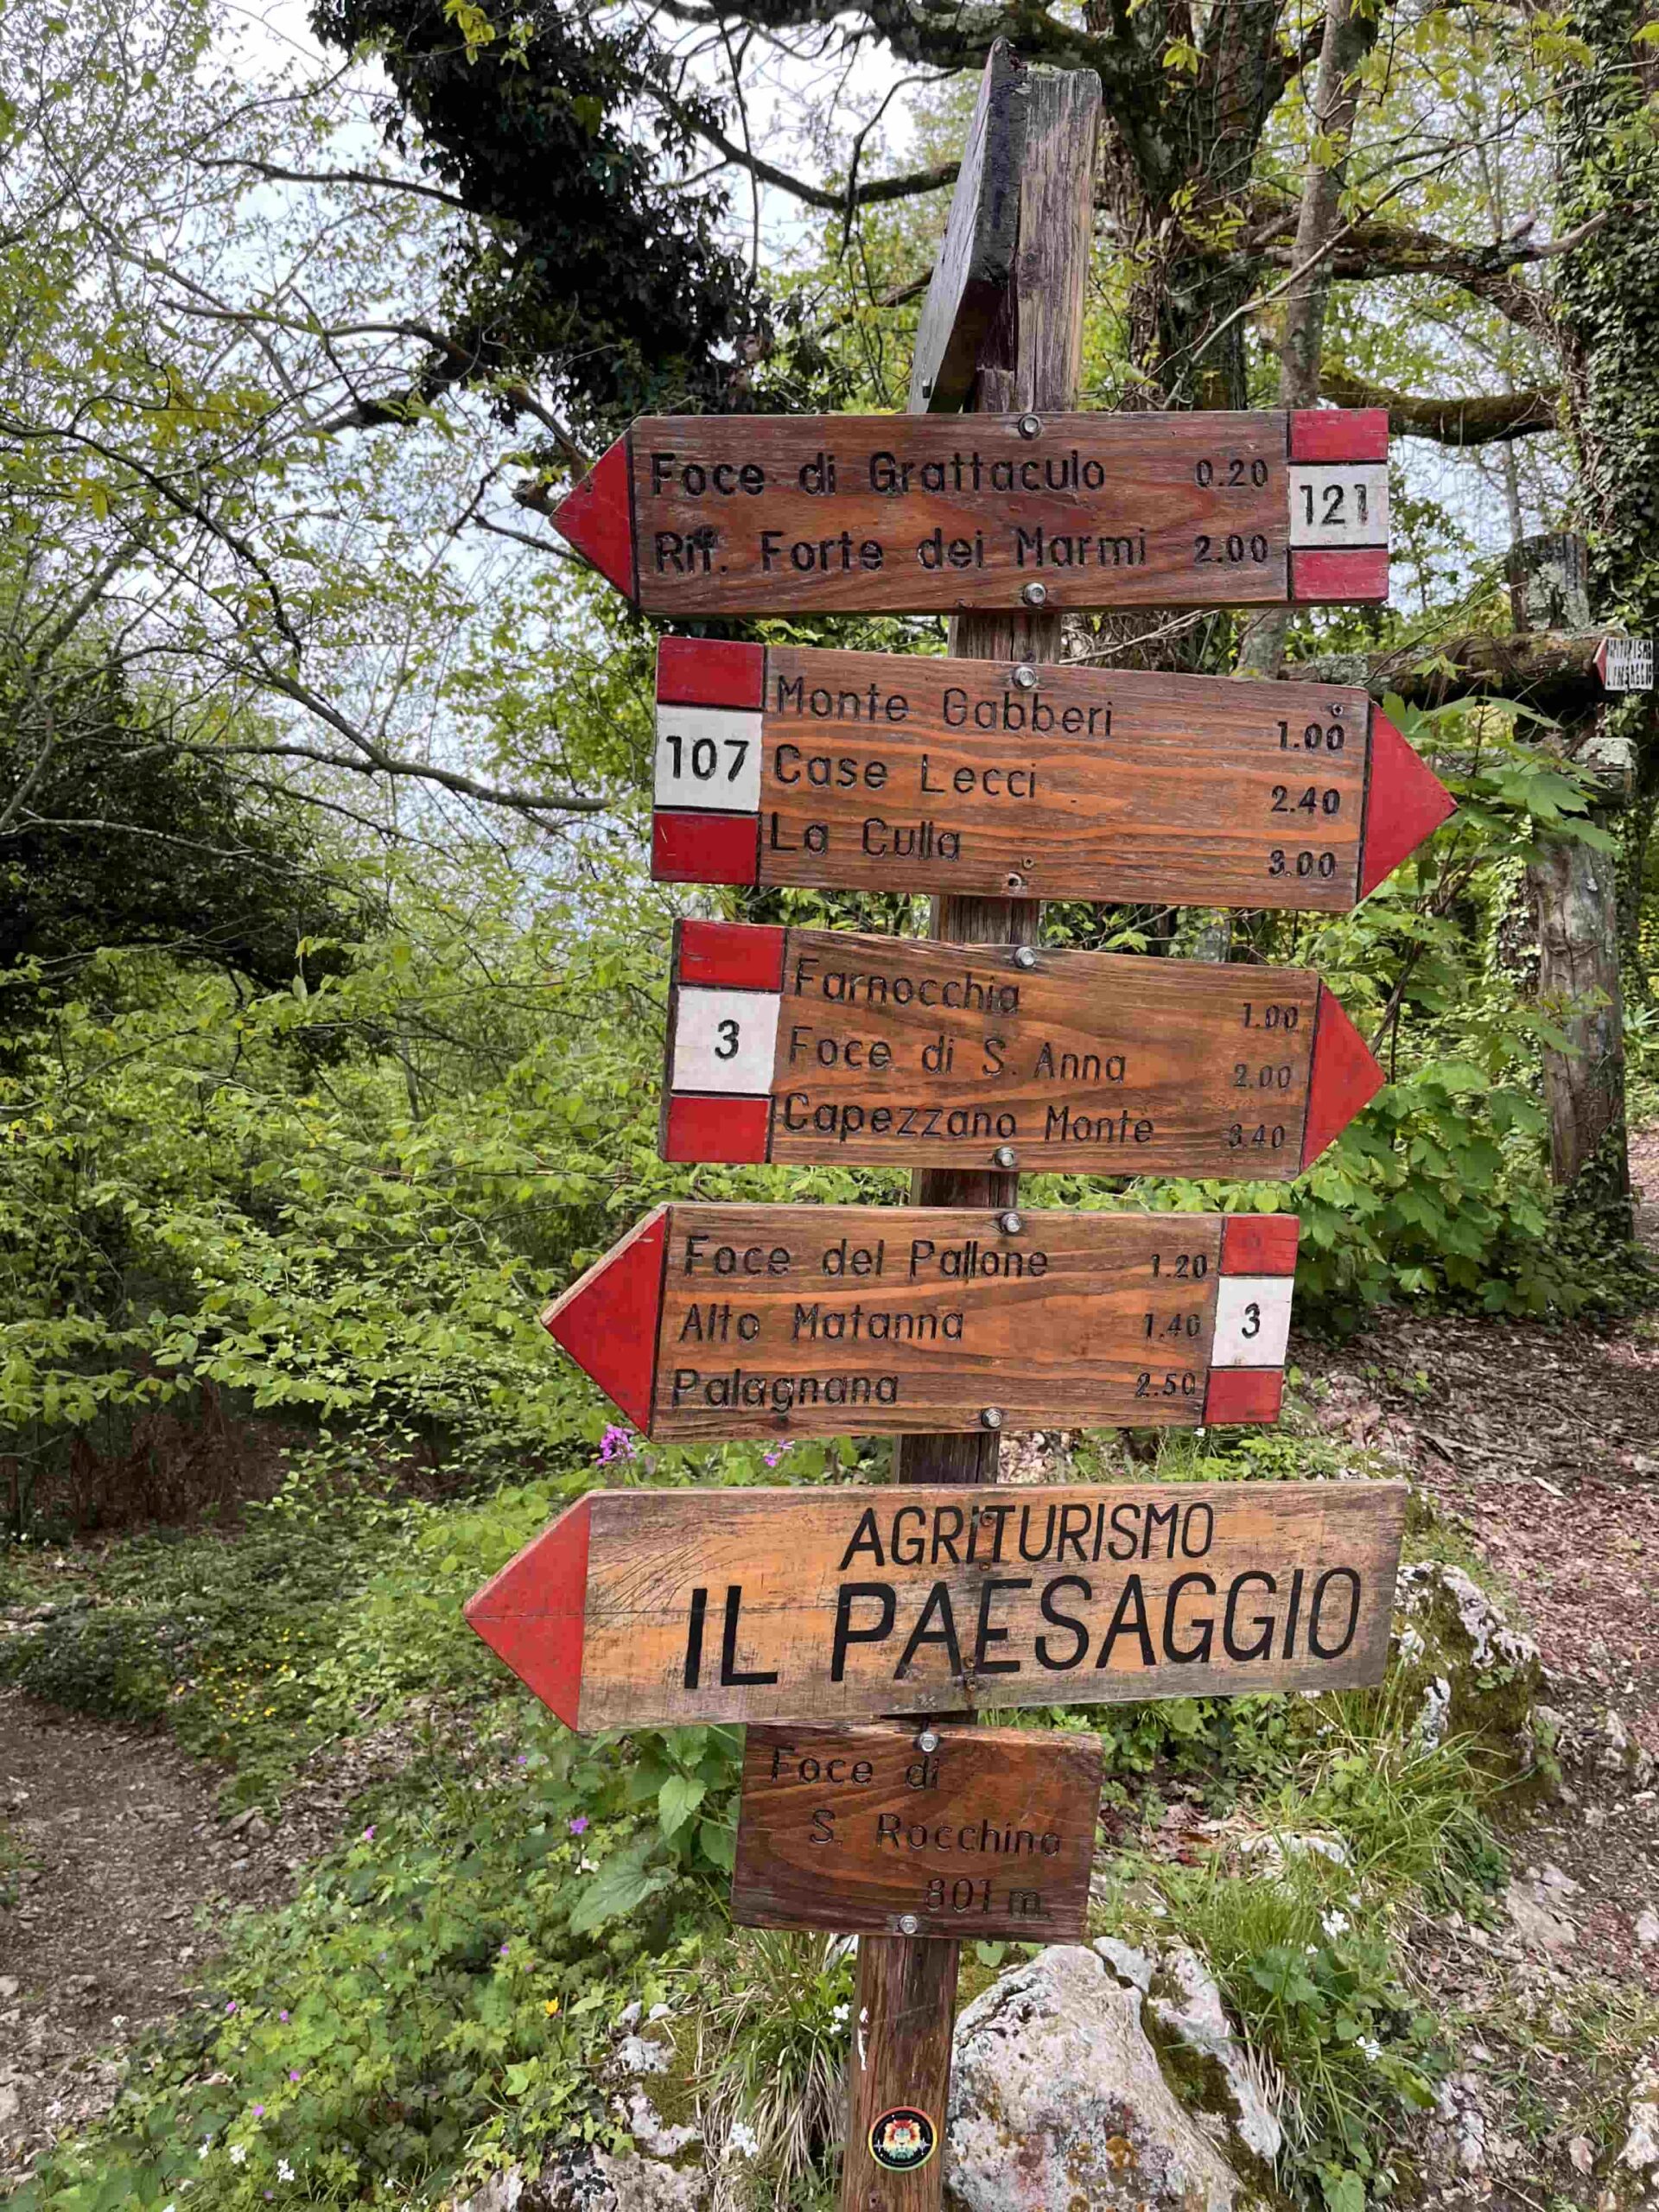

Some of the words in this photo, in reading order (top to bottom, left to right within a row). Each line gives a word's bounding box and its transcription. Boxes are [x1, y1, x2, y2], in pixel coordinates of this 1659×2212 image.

[651, 453, 766, 496] Foce
[799, 452, 836, 496] di
[869, 449, 1105, 494] Grattaculo
[1194, 458, 1268, 489] 0.20
[1300, 483, 1370, 526] 121
[655, 528, 728, 575] Rif.
[760, 531, 884, 574] Forte
[918, 527, 984, 570] dei
[1016, 527, 1147, 569] Marmi
[1194, 534, 1268, 564] 2.00
[777, 675, 909, 722] Monte
[943, 688, 1114, 737] Gabberi
[1278, 721, 1344, 750] 1.00
[665, 734, 750, 783] 107
[775, 743, 888, 789] Case
[920, 753, 1037, 799] Lecci
[1271, 785, 1340, 815] 2.40
[771, 812, 830, 856] La
[863, 817, 961, 861] Culla
[1268, 849, 1336, 878] 3.00
[794, 957, 1020, 1014] Farnocchia
[1243, 1002, 1299, 1029] 1.00
[715, 1019, 741, 1061] 3
[790, 1025, 892, 1071] Foce
[922, 1035, 954, 1075] di
[1033, 1041, 1127, 1084] Anna
[1233, 1064, 1292, 1089] 2.00
[784, 1091, 1017, 1143] Capezzano
[1044, 1104, 1154, 1144] Monte
[683, 1235, 791, 1277] Foce
[823, 1238, 884, 1278] del
[910, 1239, 1049, 1279] Pallone
[1150, 1254, 1208, 1279] 1.20
[678, 1303, 760, 1342] Alto
[791, 1302, 963, 1342] Matanna
[1143, 1313, 1201, 1339] 1.40
[1242, 1301, 1261, 1339] 3
[671, 1368, 899, 1414] Palagnana
[1135, 1372, 1196, 1398] 2.50
[839, 1502, 1215, 1572] AGRITURISMO
[683, 1584, 779, 1690] IL
[830, 1566, 1362, 1683] PAESAGGIO
[772, 1745, 874, 1784] Foce
[906, 1757, 941, 1790] di
[877, 1813, 1061, 1858] Rocchino
